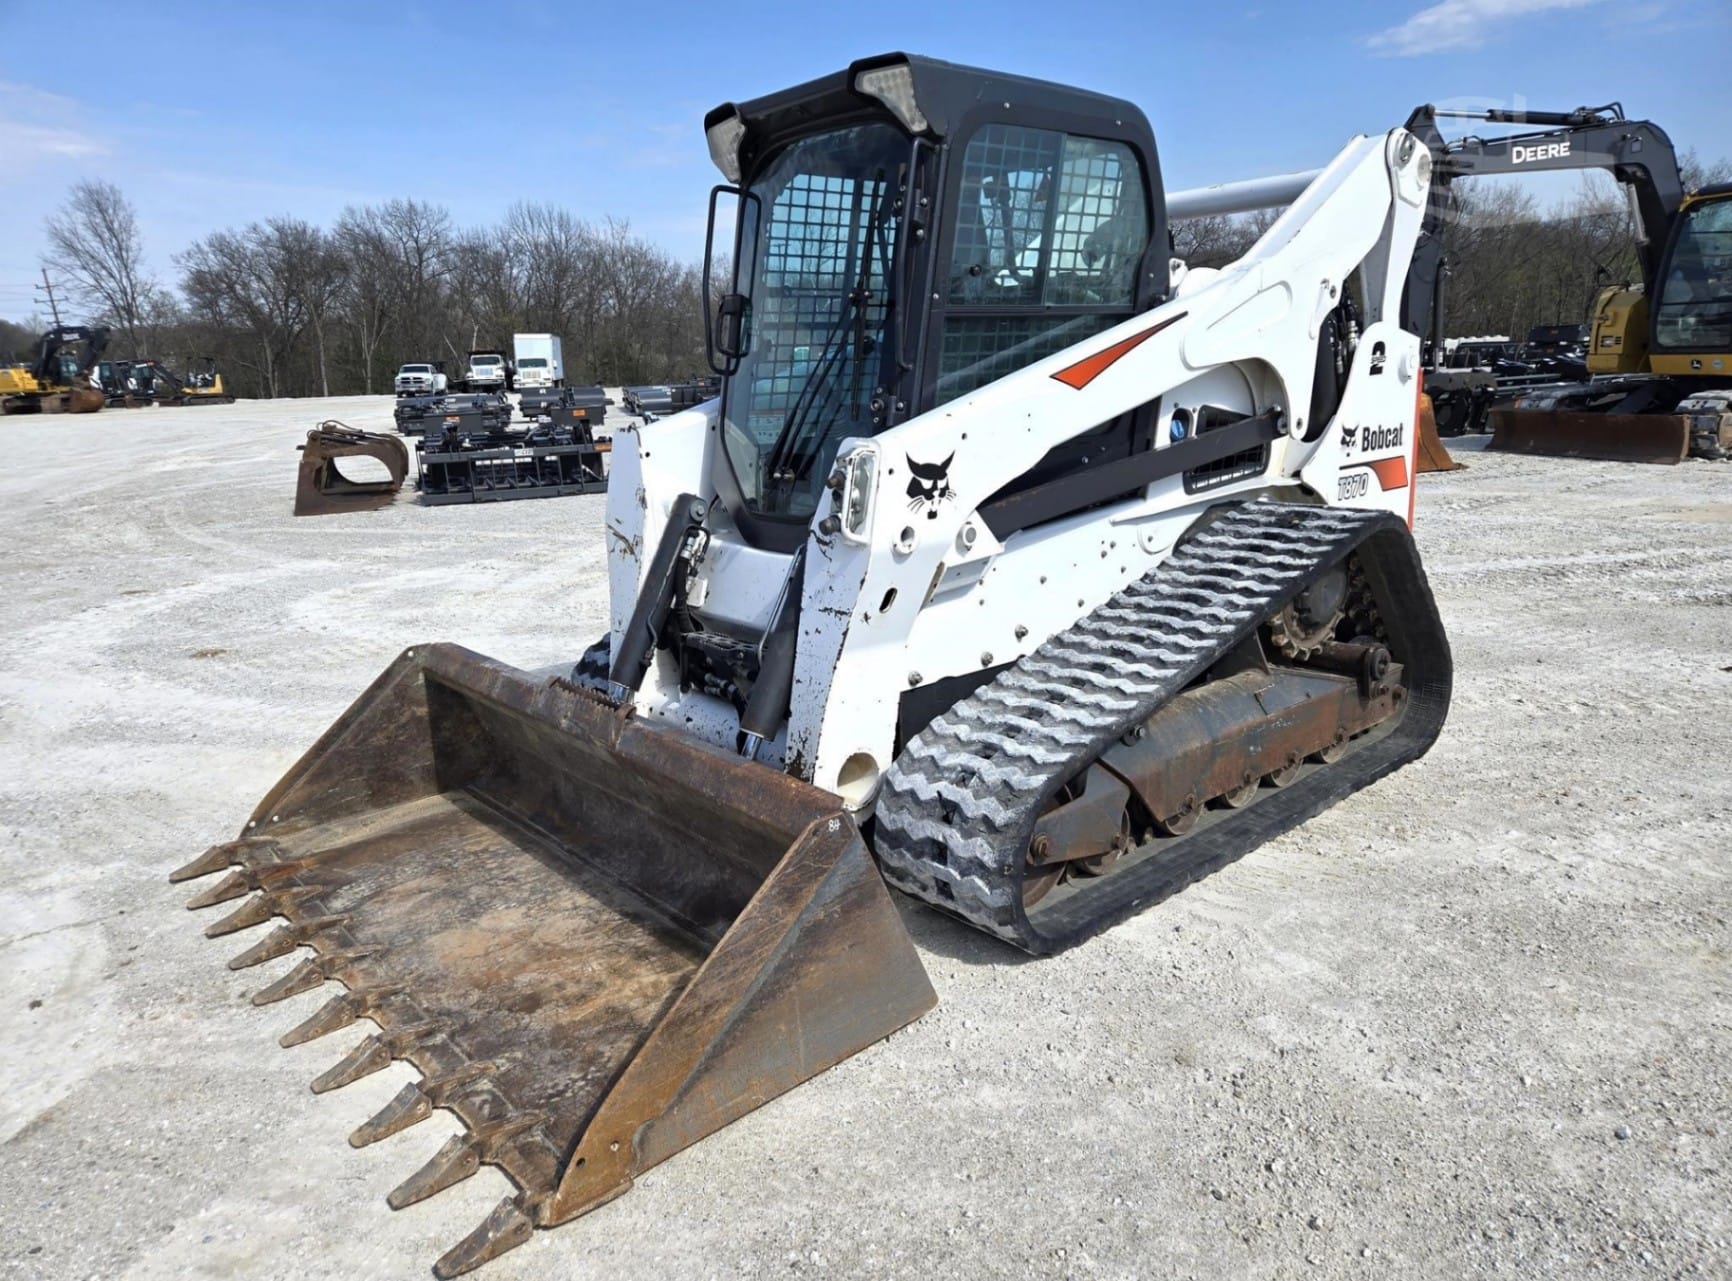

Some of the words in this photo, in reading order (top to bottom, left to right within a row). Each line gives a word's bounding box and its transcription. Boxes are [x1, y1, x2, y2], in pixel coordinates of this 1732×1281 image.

[1512, 141, 1571, 164] DEERE
[1361, 422, 1403, 452] Bobcat
[1338, 473, 1368, 501] T870
